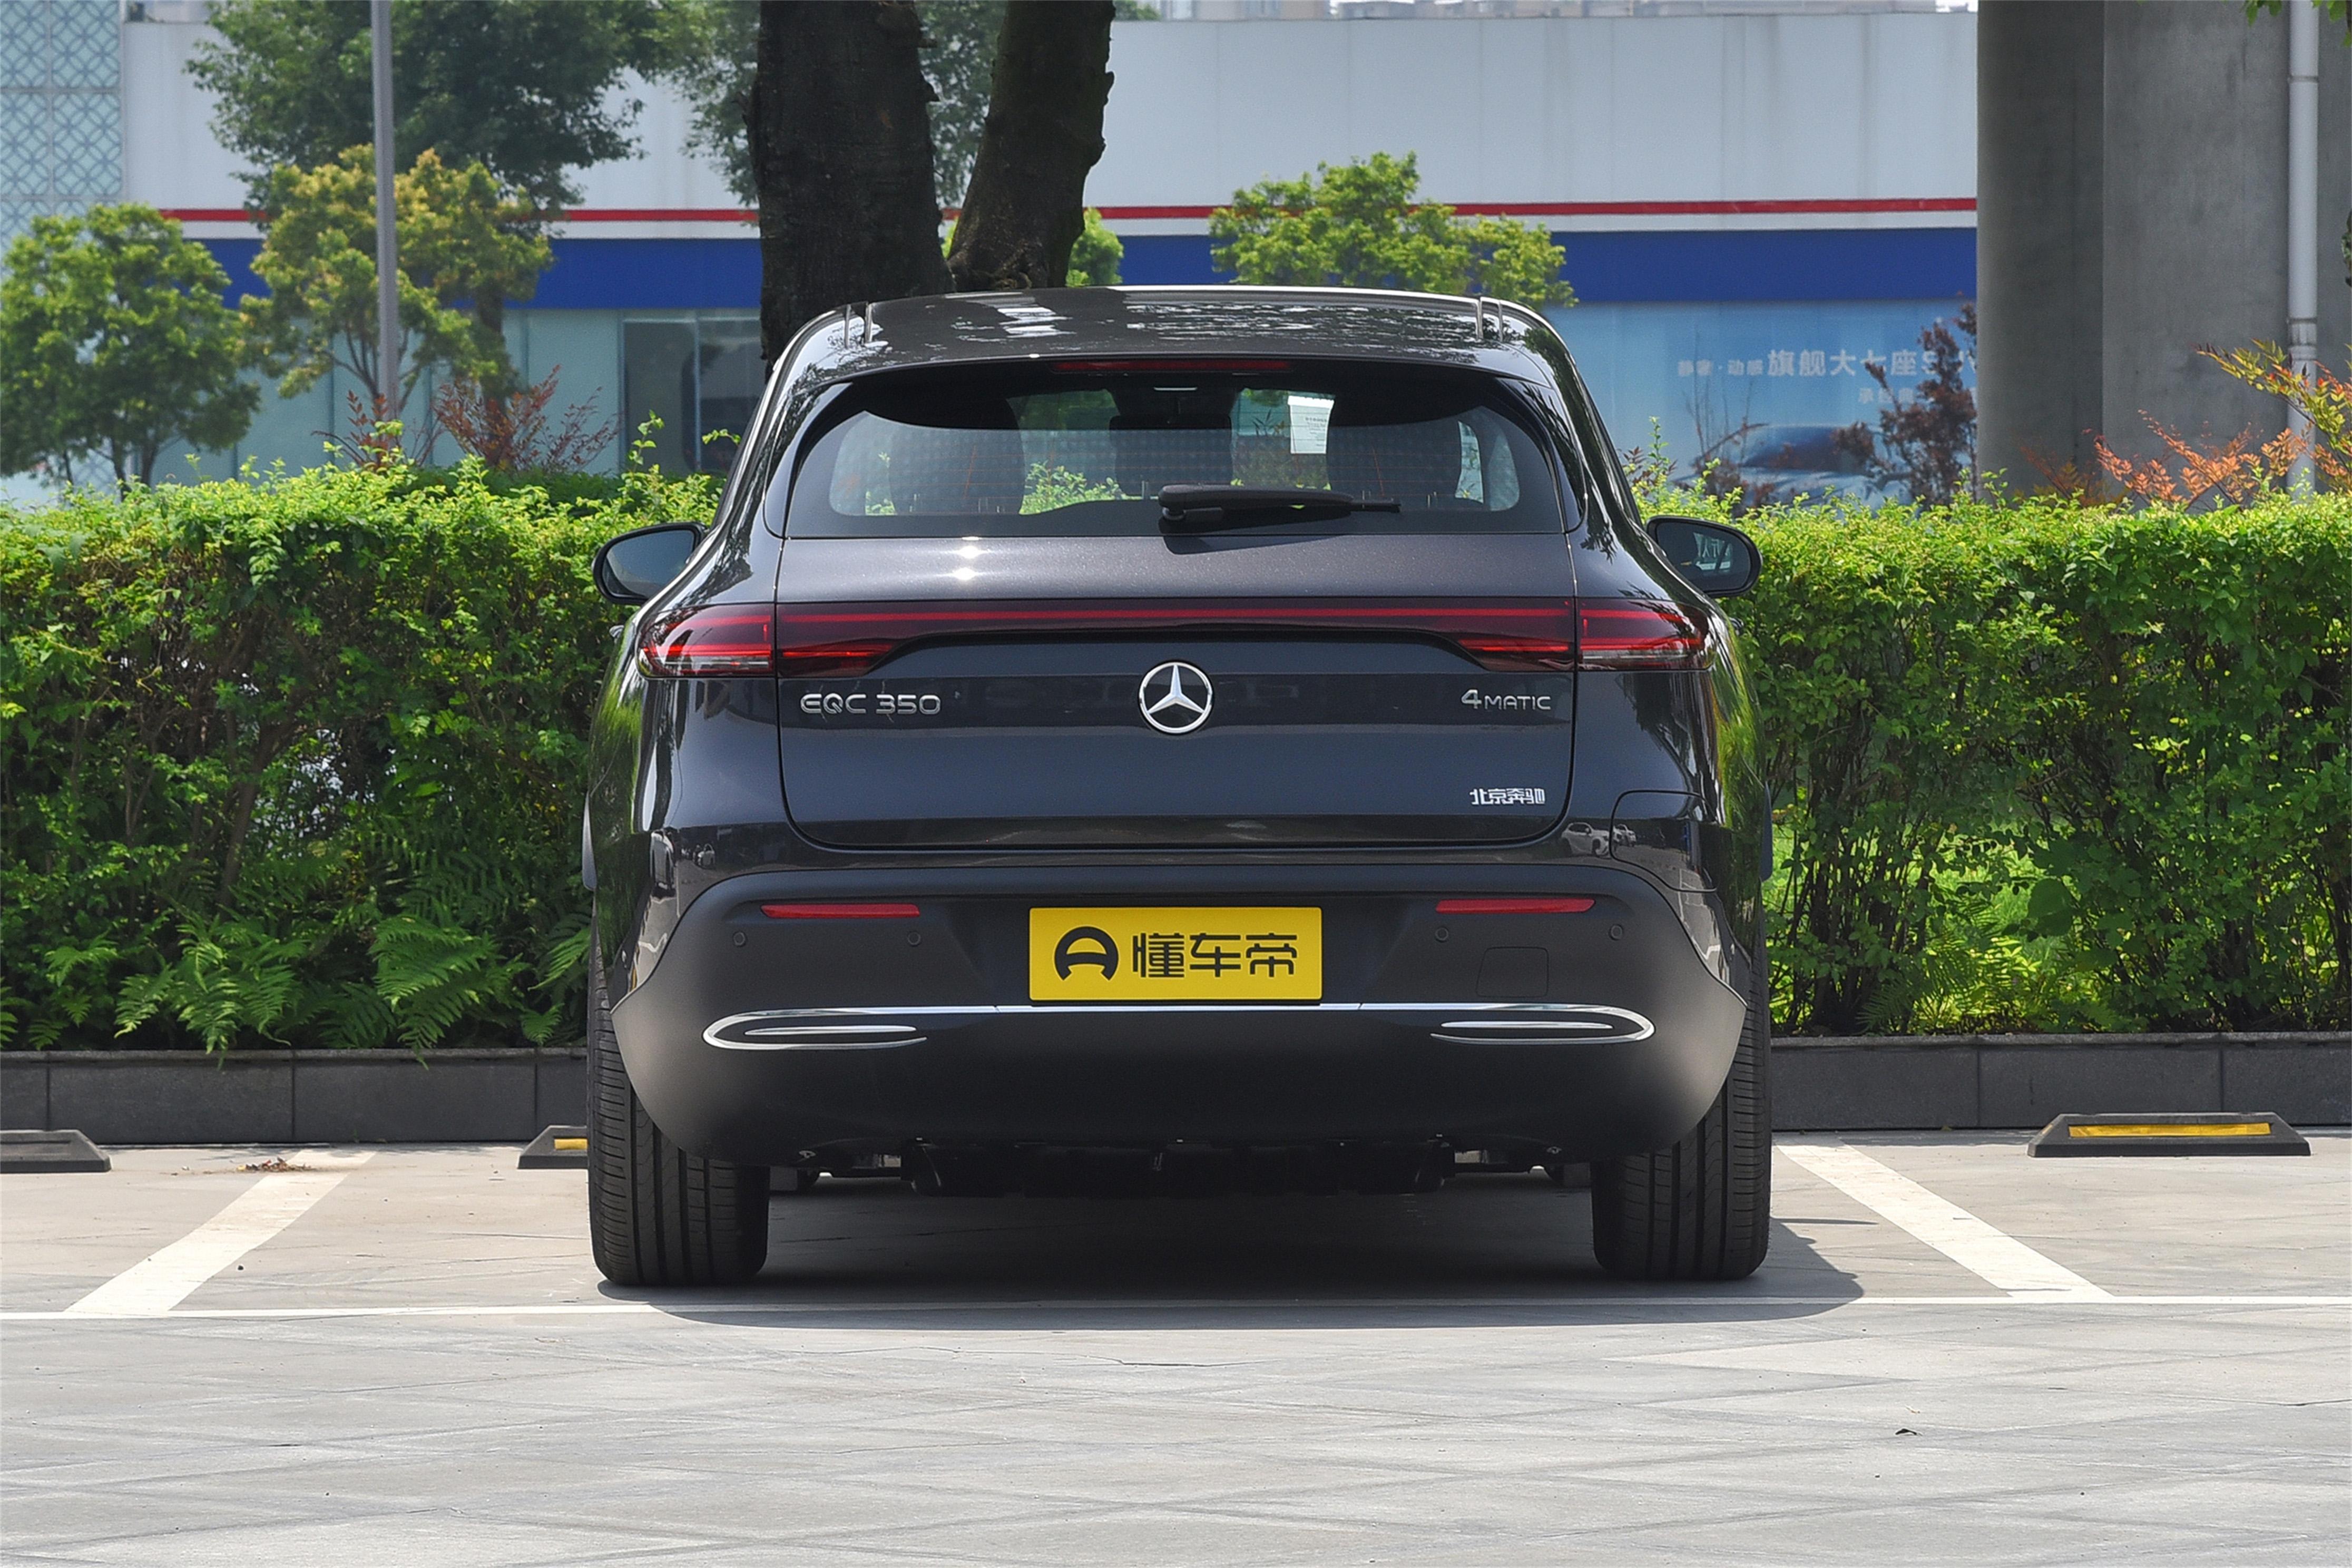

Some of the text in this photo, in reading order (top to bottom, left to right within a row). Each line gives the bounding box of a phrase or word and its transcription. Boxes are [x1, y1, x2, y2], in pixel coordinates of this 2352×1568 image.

[800, 693, 941, 714] EQC 350
[1461, 689, 1551, 710] 4MATIC
[1469, 788, 1545, 805] 北京奔驰
[1132, 932, 1297, 978] 懂车帝
